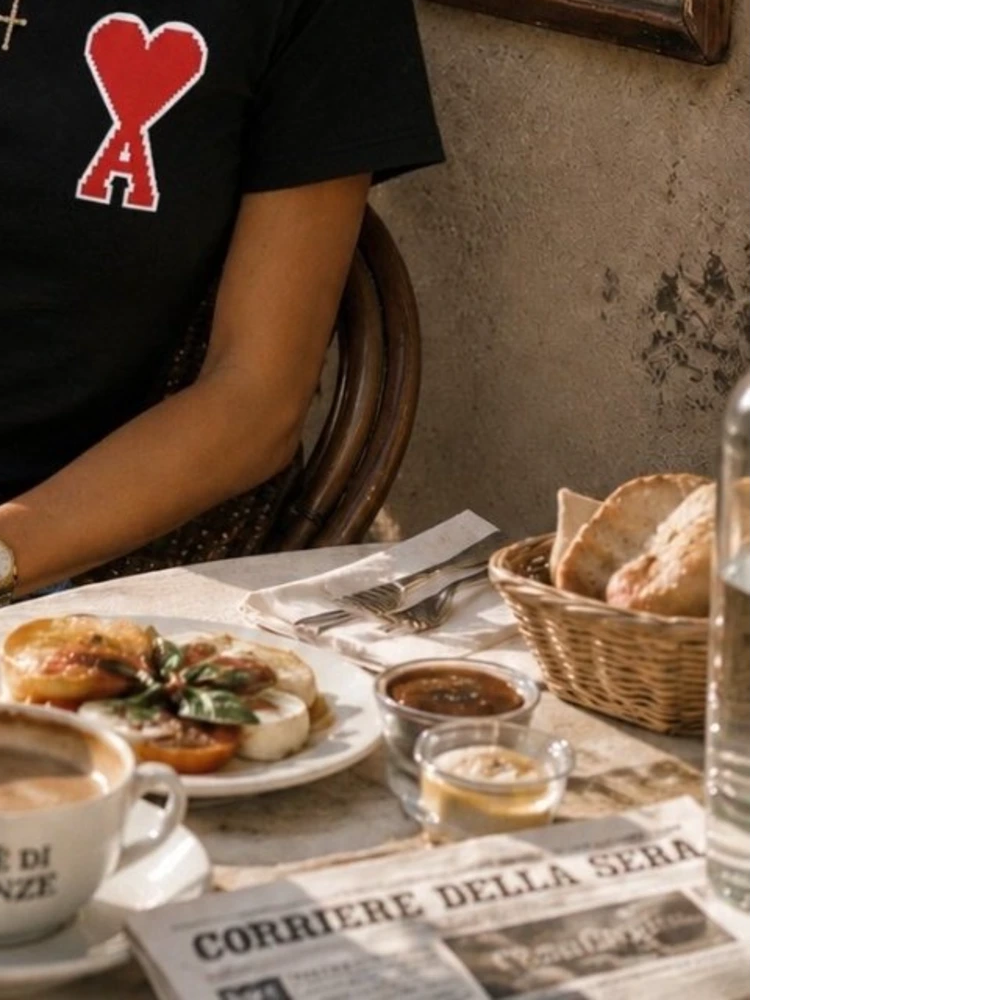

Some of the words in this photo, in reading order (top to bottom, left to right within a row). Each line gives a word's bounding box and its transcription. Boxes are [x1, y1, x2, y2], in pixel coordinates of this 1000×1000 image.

[19, 842, 52, 871] DI
[191, 890, 424, 960] CORRIERE
[435, 863, 580, 910] DELLA
[588, 838, 706, 878] SERA
